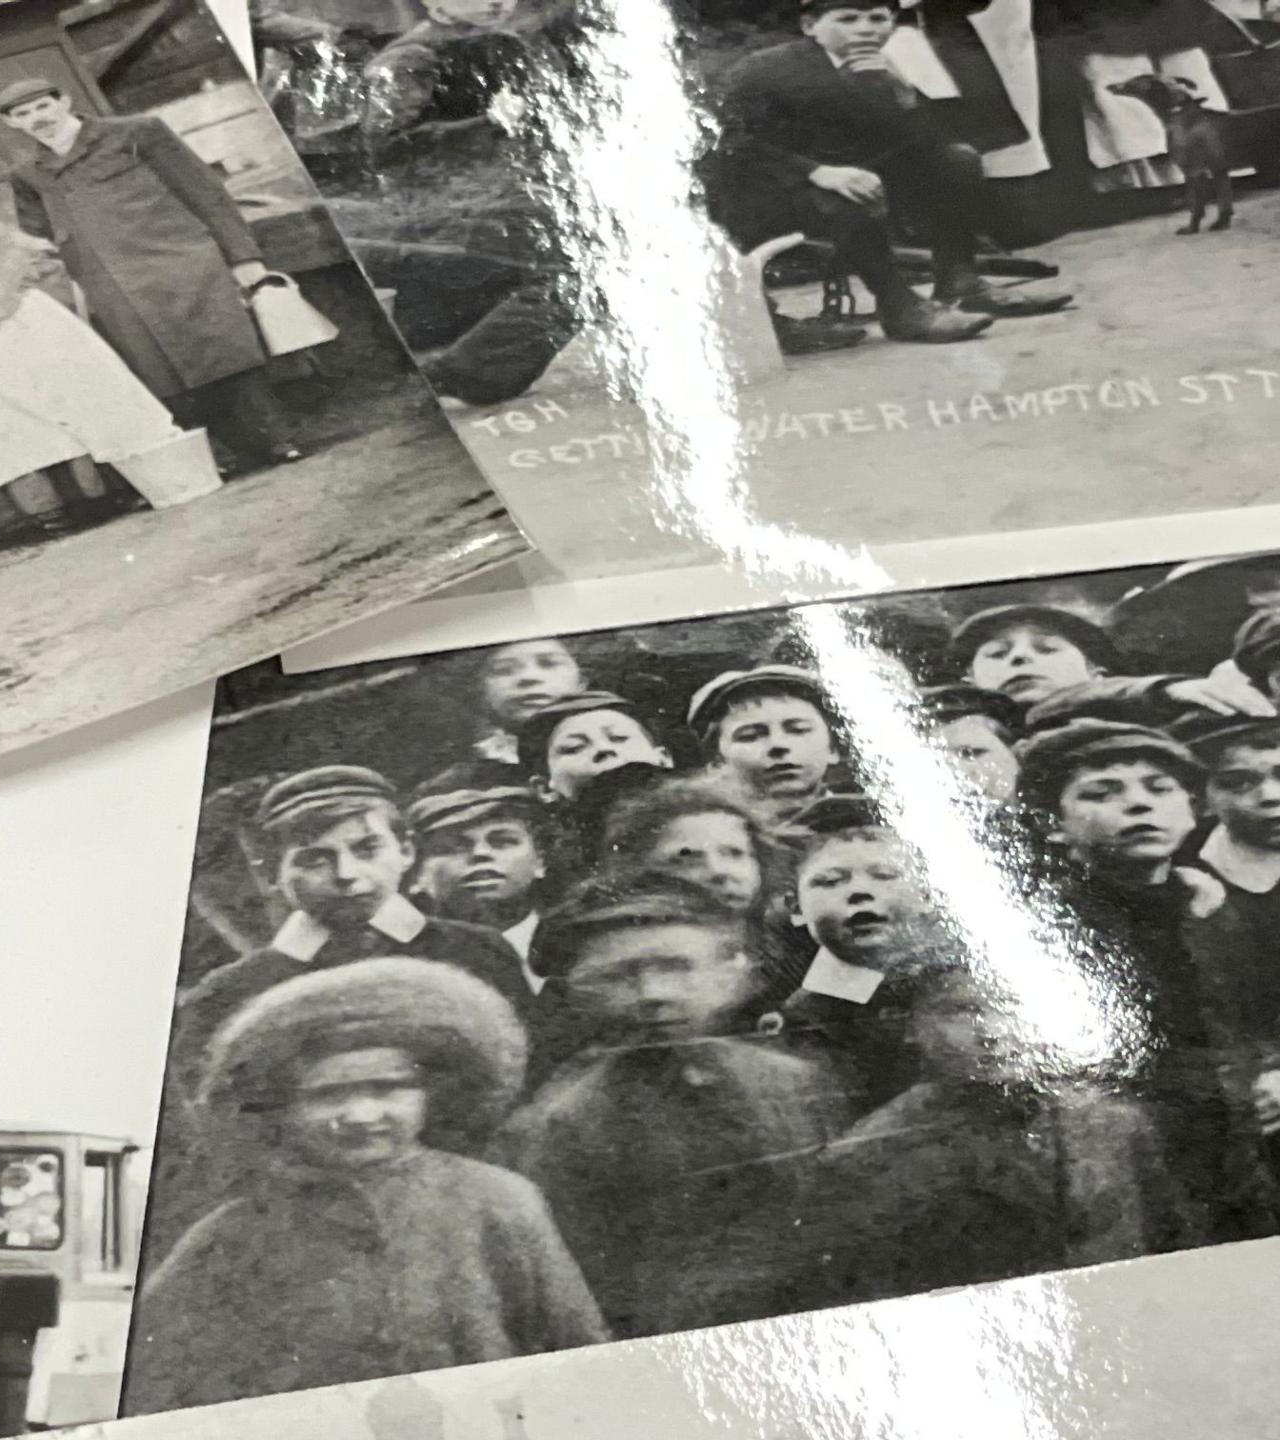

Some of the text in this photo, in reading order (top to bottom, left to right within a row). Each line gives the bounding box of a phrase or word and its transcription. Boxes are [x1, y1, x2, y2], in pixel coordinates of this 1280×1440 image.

[742, 402, 909, 442] WATER
[927, 376, 1162, 428] HAMPTON
[1178, 372, 1240, 404] ST
